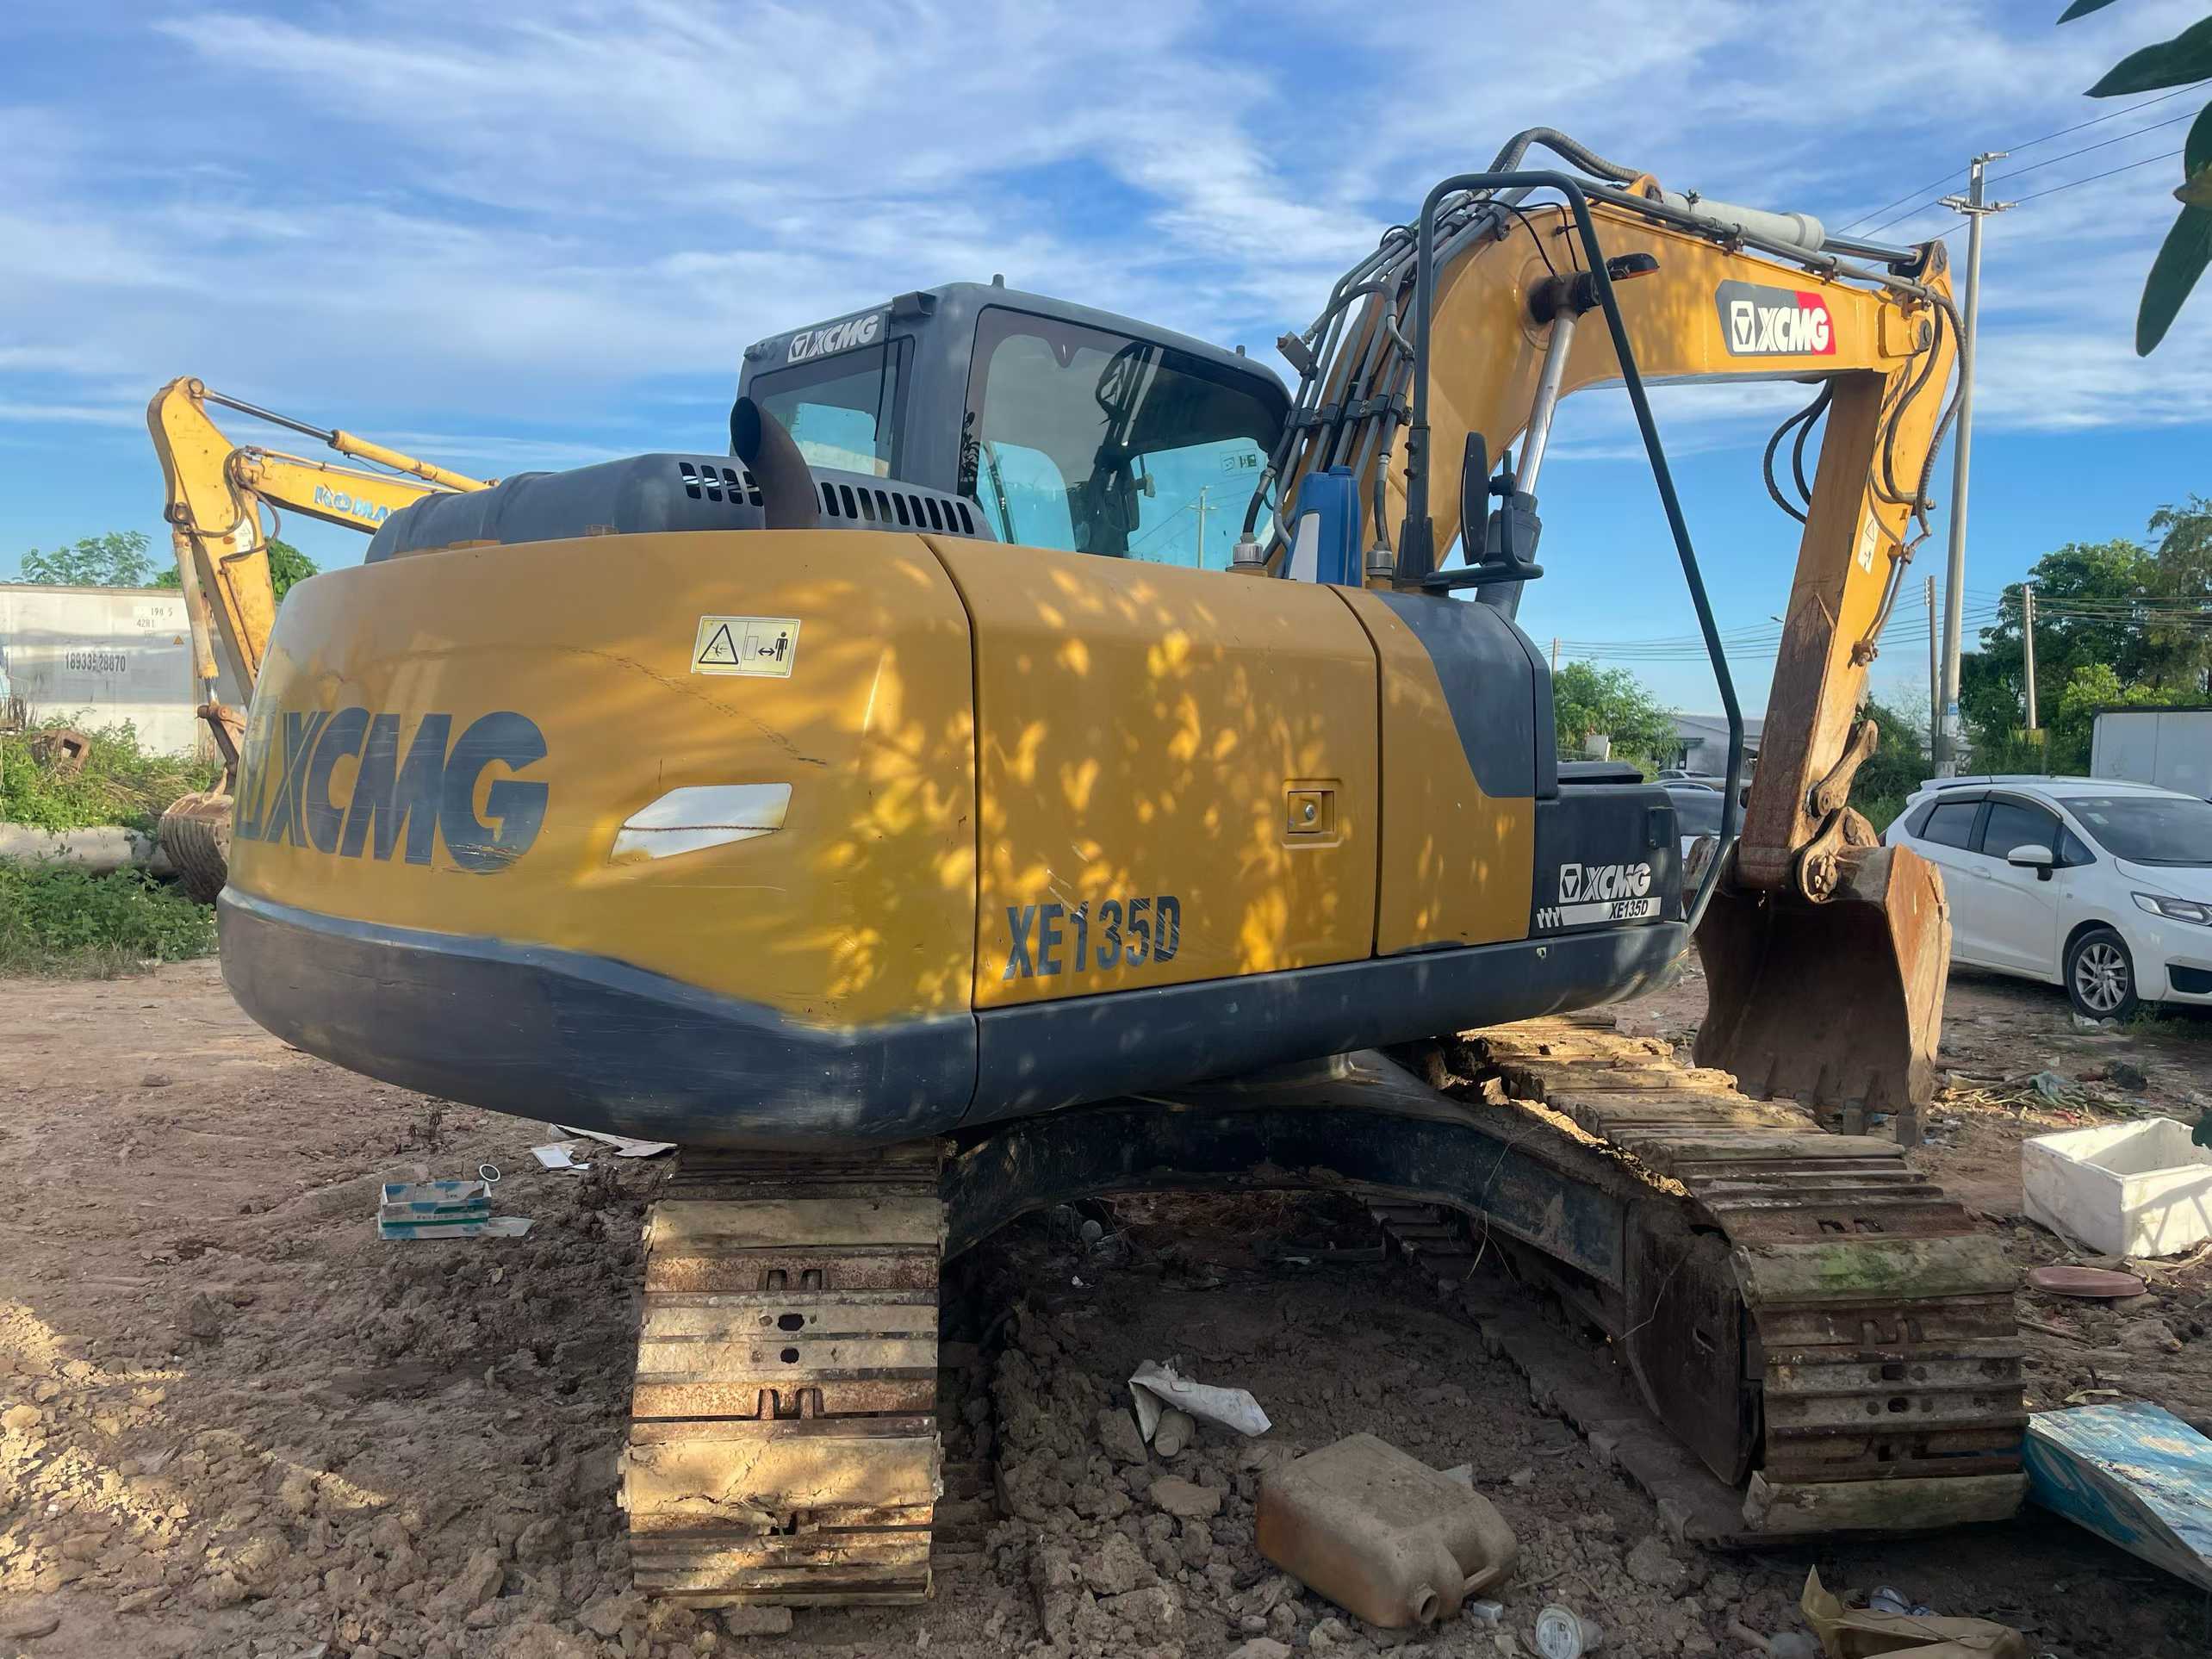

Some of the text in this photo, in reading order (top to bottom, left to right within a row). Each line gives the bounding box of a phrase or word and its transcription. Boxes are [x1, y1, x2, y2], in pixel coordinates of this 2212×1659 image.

[806, 314, 879, 358] XCMG
[1755, 306, 1830, 352] XCMG
[259, 706, 550, 876] XCMG
[1579, 862, 1652, 903] XCMG
[1609, 899, 1649, 920] XE135D
[1002, 895, 1181, 980] XE135D
